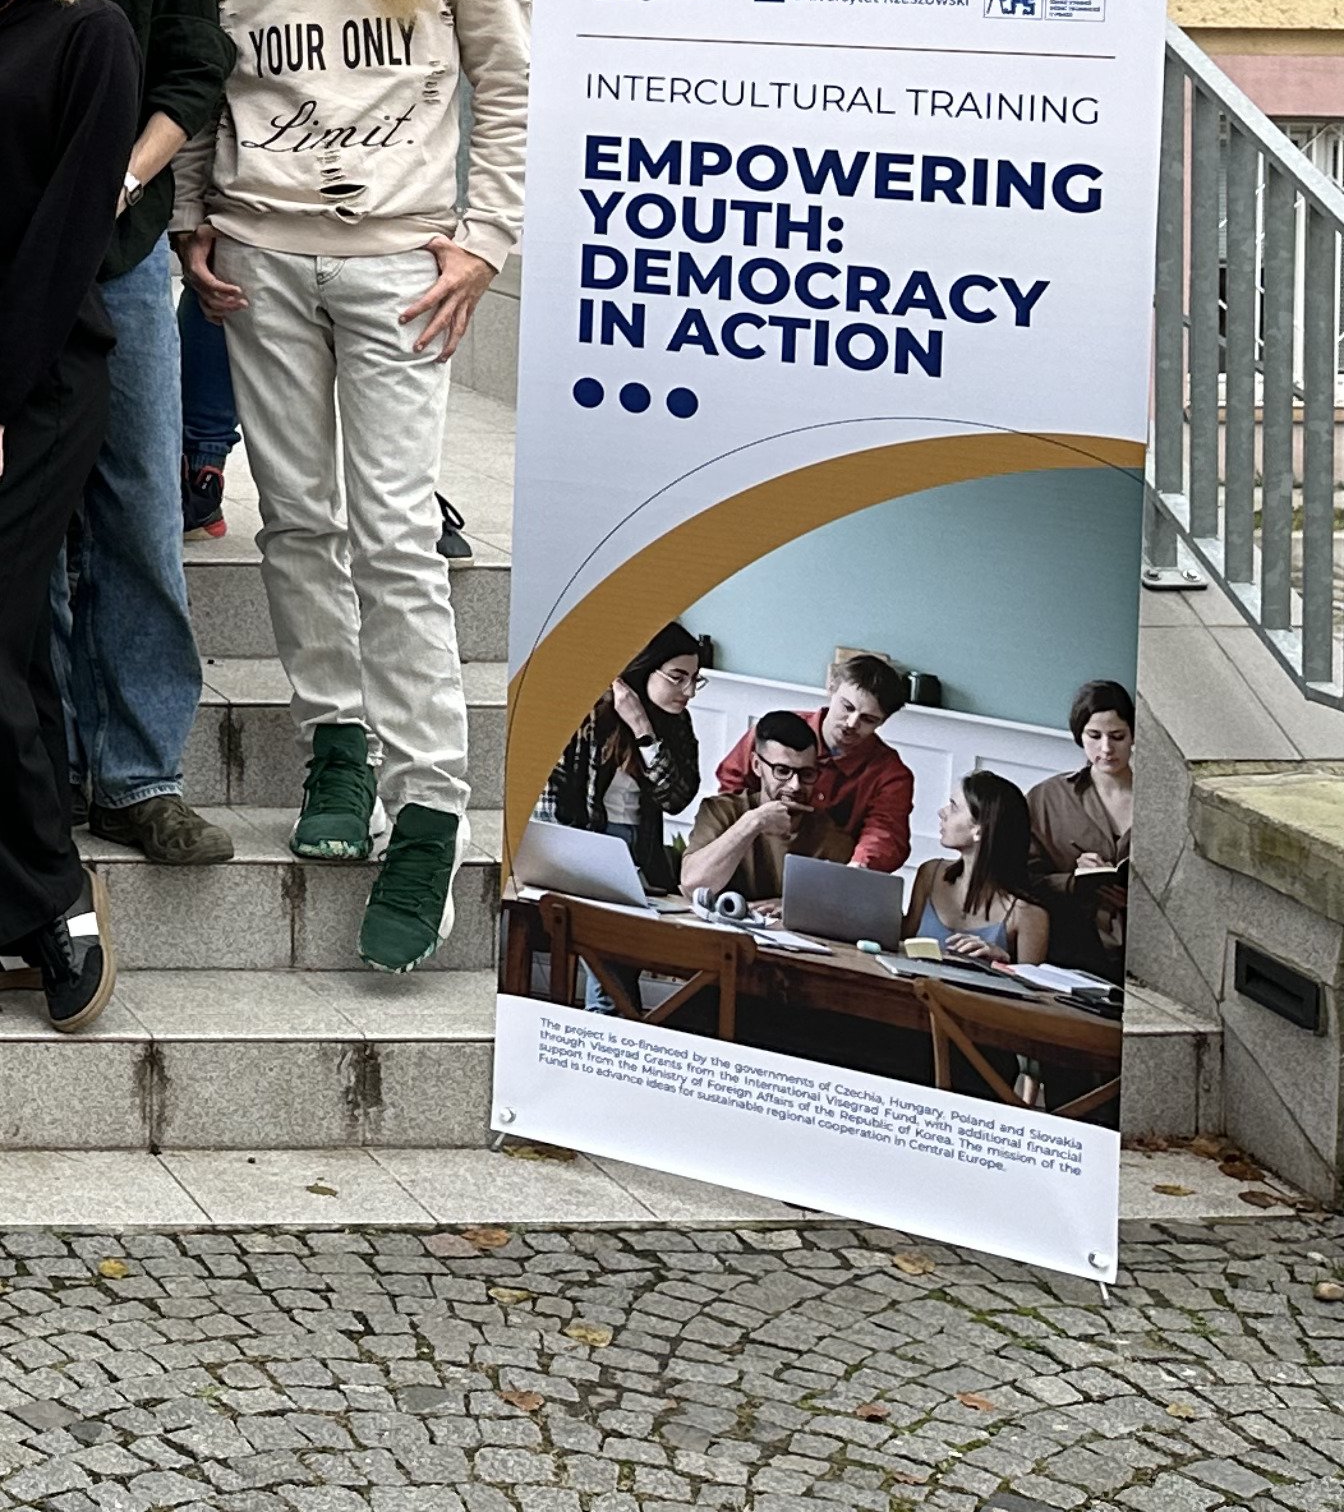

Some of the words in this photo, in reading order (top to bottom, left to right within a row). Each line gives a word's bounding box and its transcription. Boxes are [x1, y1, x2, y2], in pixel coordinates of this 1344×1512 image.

[249, 24, 327, 78] YOUR
[342, 16, 417, 70] ONLY
[241, 100, 414, 153] Limit.
[586, 73, 895, 115] INTERCULTURAL
[906, 88, 1099, 125] TRAINING
[584, 134, 1103, 215] EMPOWERING
[580, 189, 845, 253] YOUTH:
[581, 245, 1050, 329] DEMOCRACY
[578, 298, 645, 348] IN
[666, 310, 944, 378] ACTION
[539, 1053, 567, 1068] Fund
[570, 1060, 579, 1071] is
[582, 1063, 594, 1074] to
[596, 1067, 643, 1085] advance
[646, 1078, 676, 1094] ideas
[679, 1083, 695, 1097] for
[697, 1090, 763, 1114] sustainable
[766, 1107, 816, 1126] regional
[818, 1119, 891, 1144] cooperation
[894, 1136, 906, 1147] in
[909, 1139, 954, 1159] Central
[539, 1042, 582, 1059] support
[587, 1052, 613, 1065] from
[618, 1060, 638, 1072] the
[642, 1065, 688, 1085] Ministry
[691, 1076, 703, 1087] of
[707, 1079, 752, 1098] Foreign
[756, 1091, 794, 1108] Affairs
[798, 1101, 811, 1112] of
[814, 1105, 835, 1118] the
[840, 1110, 894, 1133] Republic
[898, 1124, 911, 1135] of
[959, 1137, 982, 1153] The
[987, 1146, 1036, 1165] mission
[1041, 1159, 1054, 1170] of
[1059, 1161, 1082, 1176] the
[540, 1017, 561, 1031] The
[565, 1025, 604, 1040] project
[609, 1033, 617, 1043] is
[621, 1038, 688, 1059] co-financed
[693, 1051, 707, 1065] by
[711, 1057, 731, 1069] the
[735, 1062, 814, 1088] governments
[819, 1082, 831, 1092] of
[951, 1110, 995, 1130] Poland
[1000, 1124, 1025, 1137] and
[1030, 1128, 1082, 1150] Slovakia
[540, 1030, 586, 1049] through
[590, 1040, 640, 1060] Visegrad
[644, 1053, 682, 1070] Grants
[686, 1062, 715, 1077] from
[720, 1071, 739, 1083] the
[744, 1076, 820, 1102] International
[825, 1094, 880, 1116] Visegrad
[924, 1119, 952, 1133] with
[957, 1126, 1021, 1149] additional
[1026, 1141, 1082, 1163] financial
